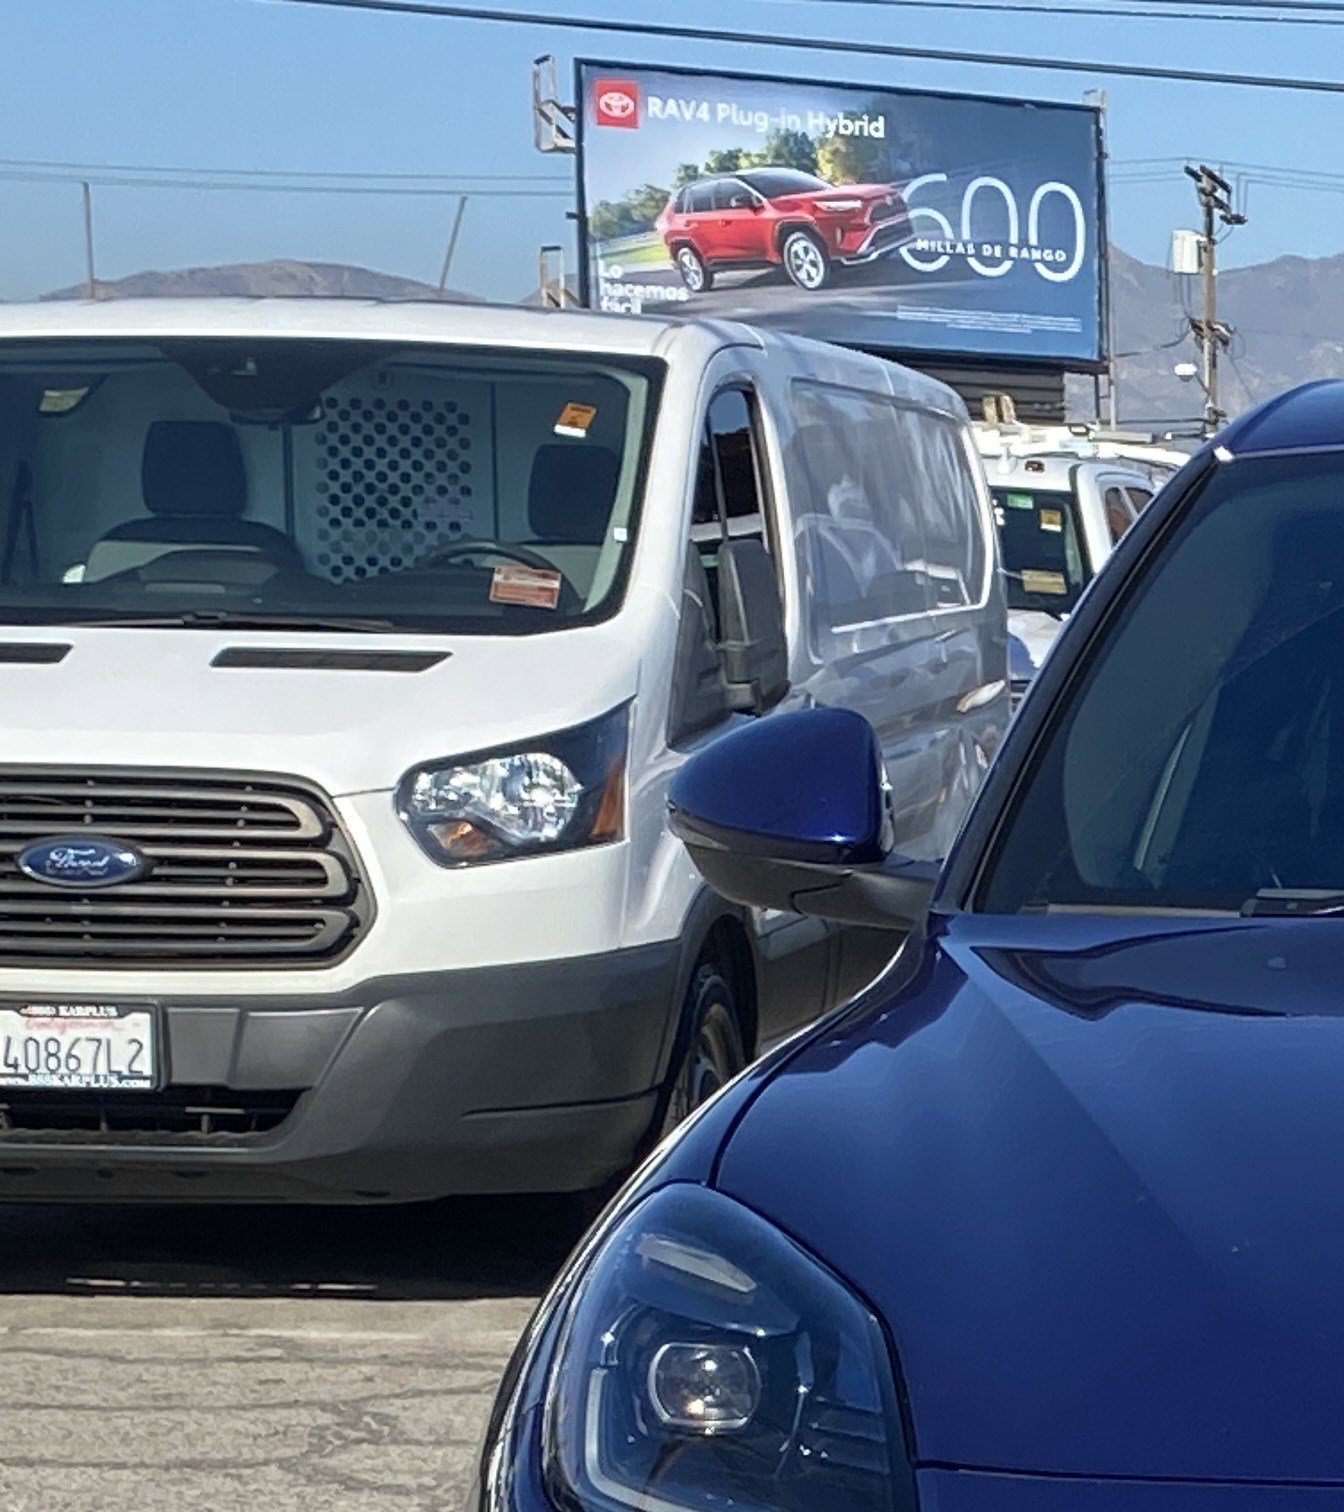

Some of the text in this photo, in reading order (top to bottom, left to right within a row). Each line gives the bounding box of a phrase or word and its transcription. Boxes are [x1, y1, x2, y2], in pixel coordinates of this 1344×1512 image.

[648, 96, 885, 138] RAV4 Plug-in Hybrid
[900, 173, 1086, 283] 600
[916, 238, 1067, 262] MILLAS DE RANGO
[599, 258, 623, 278] Lo
[600, 279, 689, 302] hacemos
[48, 847, 110, 869] Ford
[4, 1036, 144, 1075] 40867L2
